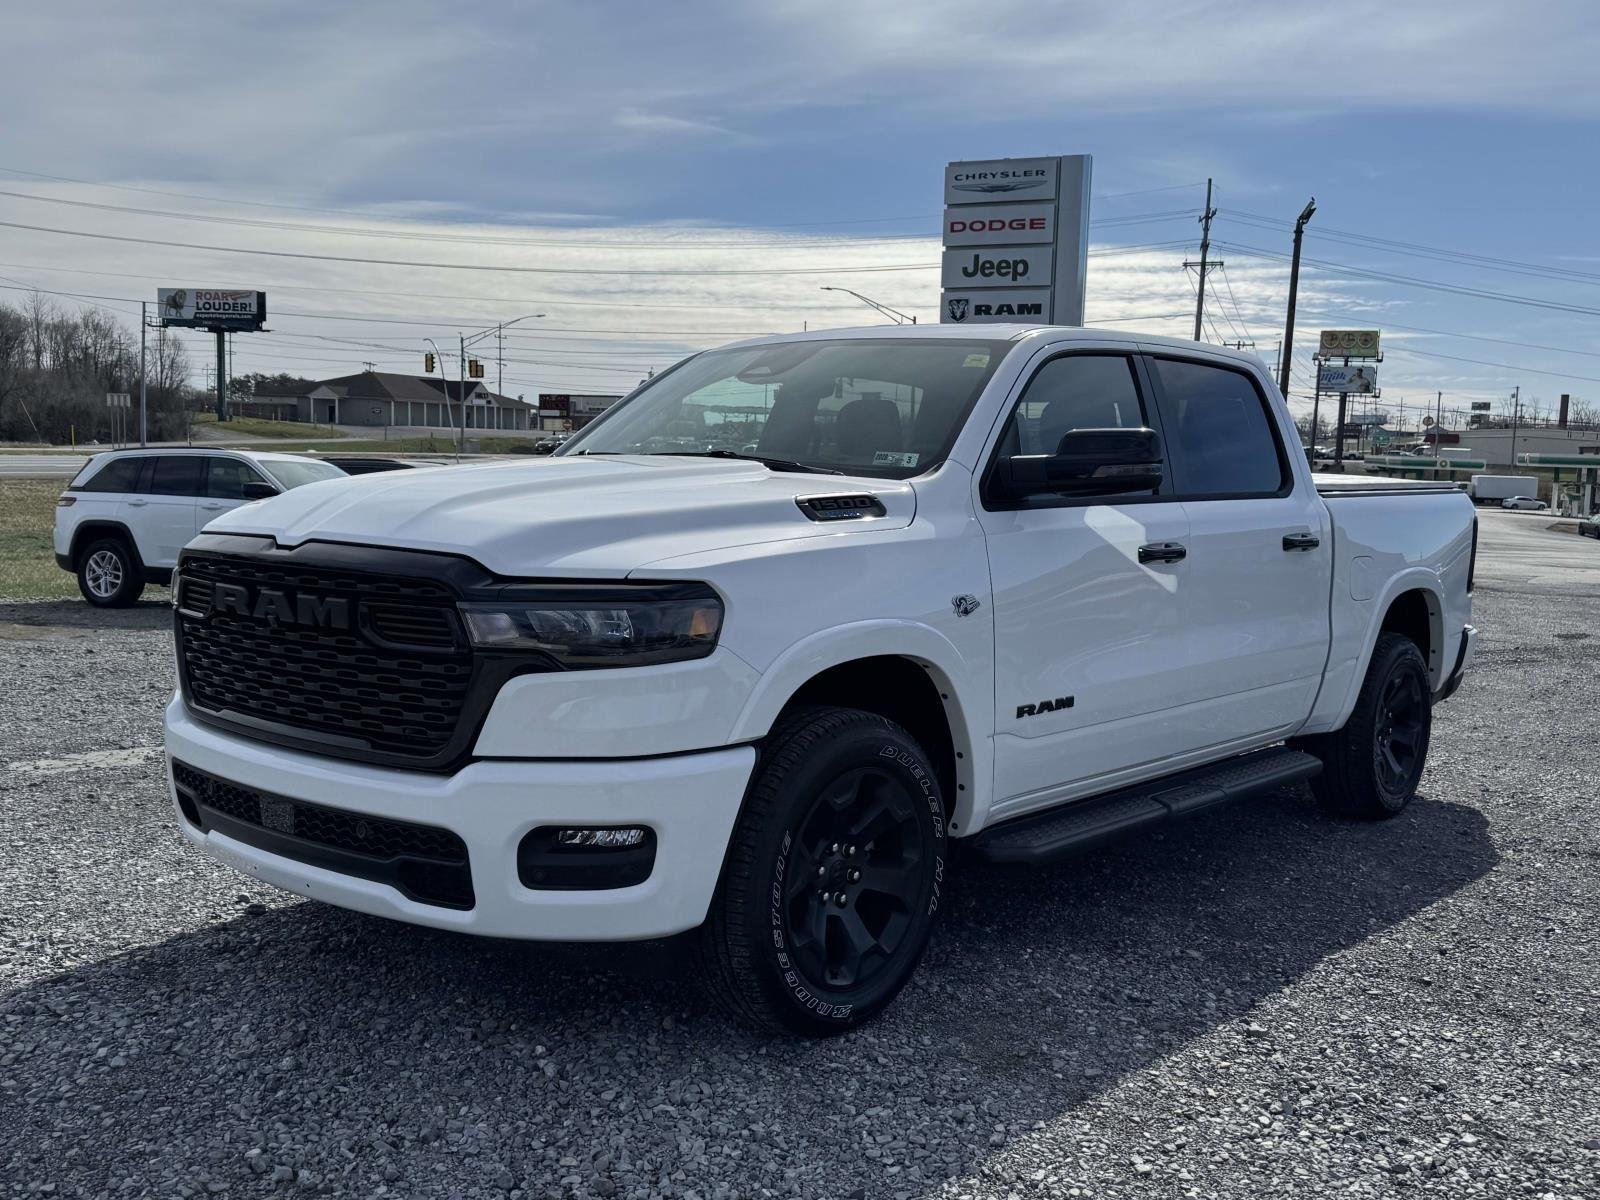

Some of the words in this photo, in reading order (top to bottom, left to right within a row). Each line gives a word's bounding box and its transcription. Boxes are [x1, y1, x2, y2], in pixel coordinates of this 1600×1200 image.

[954, 169, 1046, 182] CHRYSLER
[950, 218, 1046, 233] DODGE
[962, 254, 1029, 281] Jeep
[195, 291, 228, 301] ROAR
[196, 301, 252, 312] LOUDER!
[974, 303, 1042, 316] RAM
[814, 498, 872, 511] 1500
[215, 583, 350, 629] RAM
[1016, 695, 1075, 719] RAM
[880, 745, 945, 838] DUELER
[772, 830, 852, 1018] BRIDGESTONE
